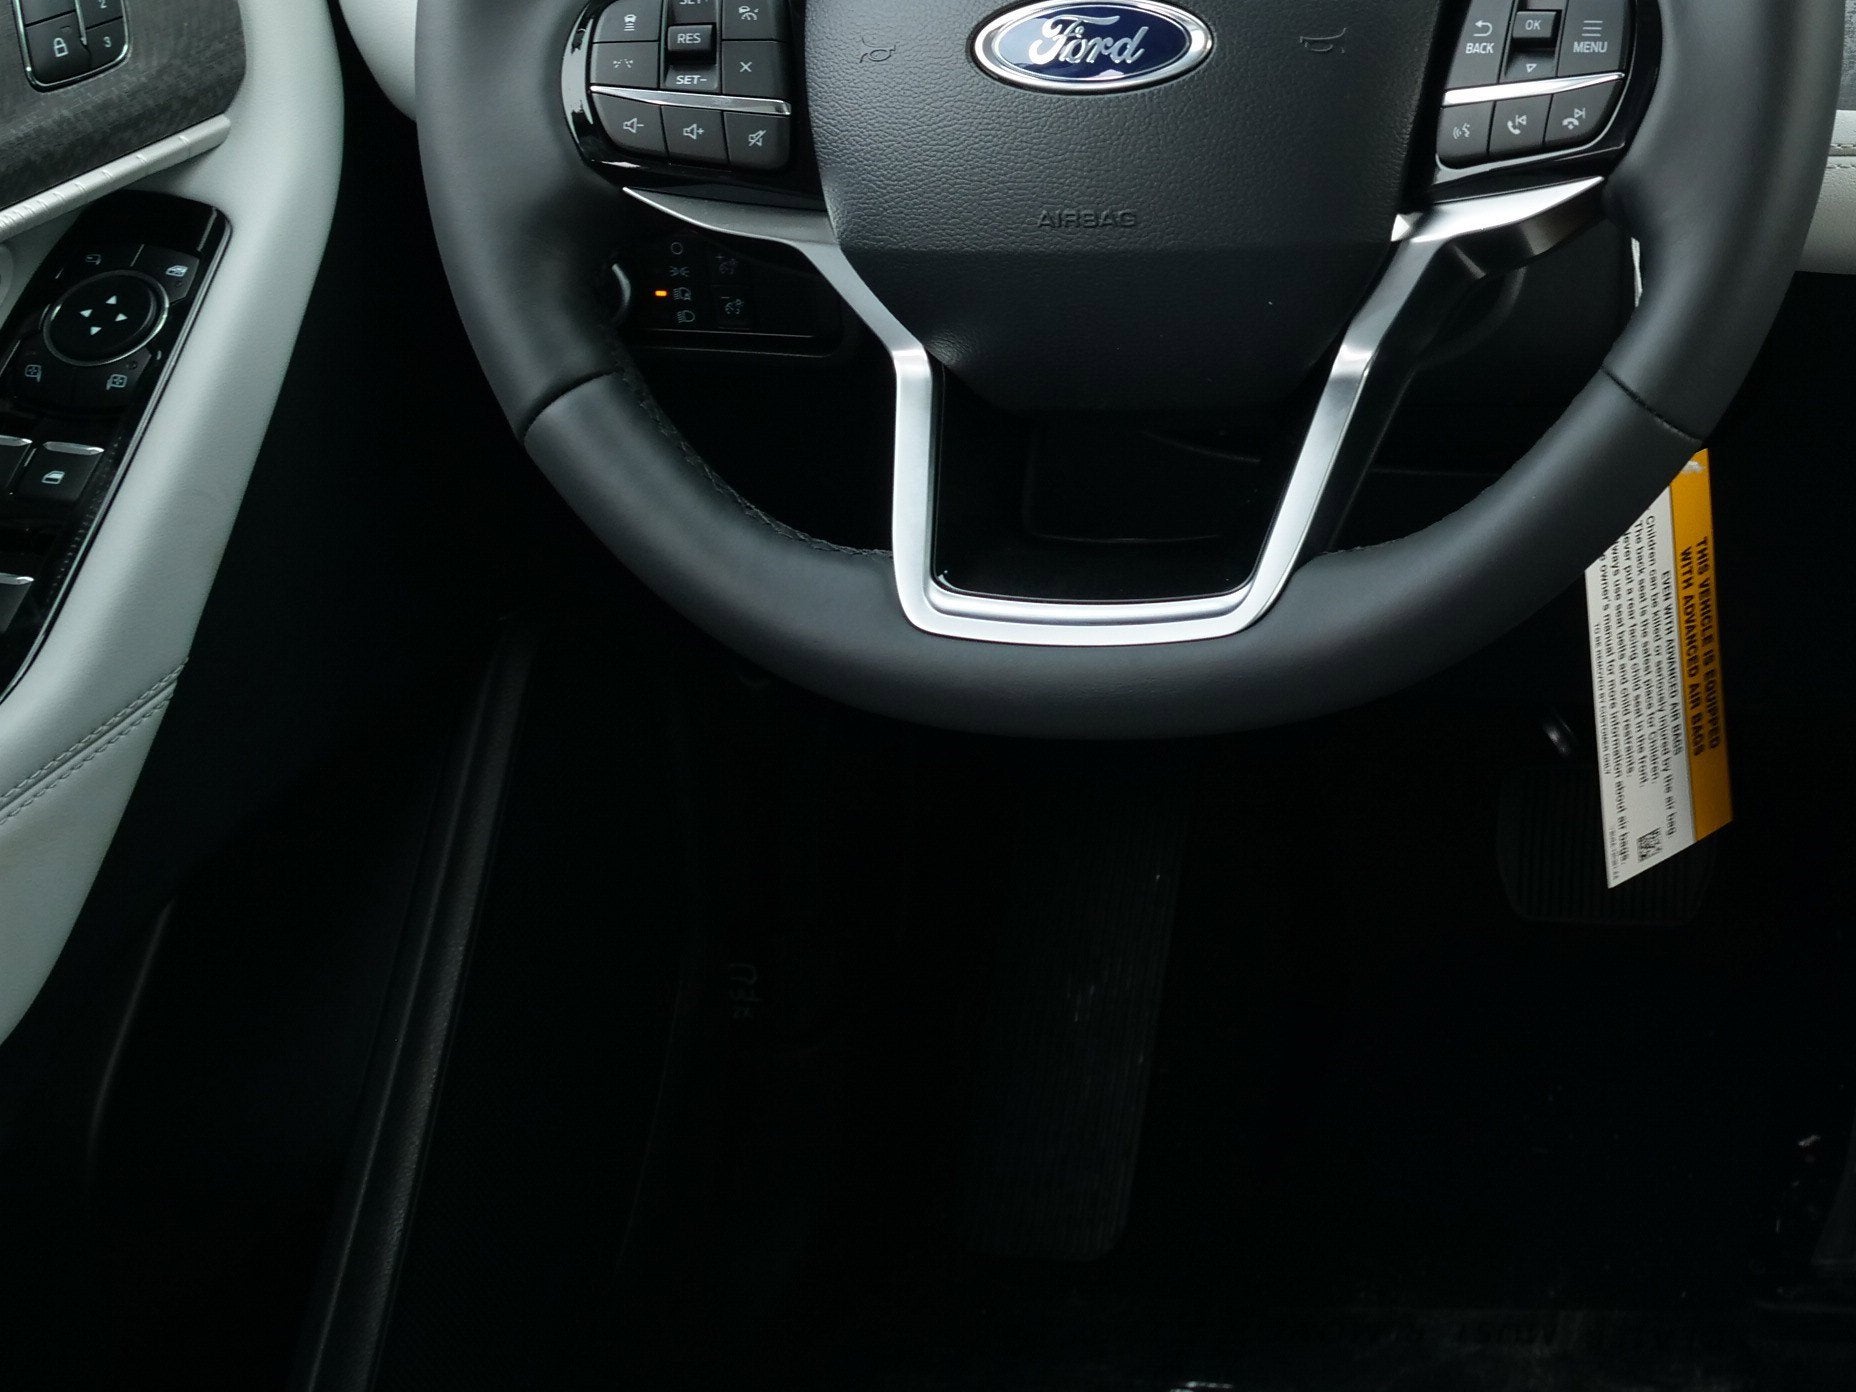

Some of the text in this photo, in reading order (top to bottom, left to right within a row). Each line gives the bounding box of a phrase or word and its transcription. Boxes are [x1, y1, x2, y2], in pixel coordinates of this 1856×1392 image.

[1525, 19, 1541, 31] OK
[103, 36, 112, 48] 3
[677, 33, 701, 44] RES
[1029, 13, 1149, 68] Ford
[1465, 42, 1495, 54] BACK
[1573, 41, 1608, 53] MENU
[1037, 209, 1140, 229] AIRBAG
[1634, 520, 1643, 544] The
[1645, 514, 1657, 566] Children
[1636, 546, 1645, 575] back
[1600, 563, 1610, 610] owner's
[1623, 564, 1633, 586] put
[1649, 568, 1657, 590] can
[1638, 577, 1647, 603] seat
[1651, 591, 1660, 608] be
[1640, 604, 1648, 616] is
[1603, 613, 1613, 656] manual
[1641, 618, 1649, 637] the
[1652, 609, 1662, 642] killed
[1626, 623, 1638, 661] facing
[1654, 644, 1662, 657] or
[1680, 547, 1704, 756] WITH ADVANCED AIR BAGS
[1695, 536, 1720, 749] THIS VEHICLE IS EQUIPPED
[1606, 658, 1615, 675] for
[1642, 640, 1652, 676] safest
[1661, 570, 1682, 755] EVEN WITH ADVANCED AIR BAGS
[1631, 661, 1640, 691] child
[1653, 658, 1667, 713] seriously
[1607, 678, 1615, 708] more
[1643, 677, 1654, 710] place
[1633, 693, 1642, 718] seat
[1635, 720, 1643, 732] in
[1647, 711, 1655, 728] for
[1610, 711, 1622, 778] information
[1636, 734, 1645, 753] the
[1657, 714, 1670, 757] injured
[1660, 757, 1671, 774] by
[1663, 773, 1673, 793] the
[1614, 780, 1624, 813] about
[1665, 794, 1674, 810] air
[1617, 815, 1625, 830] air
